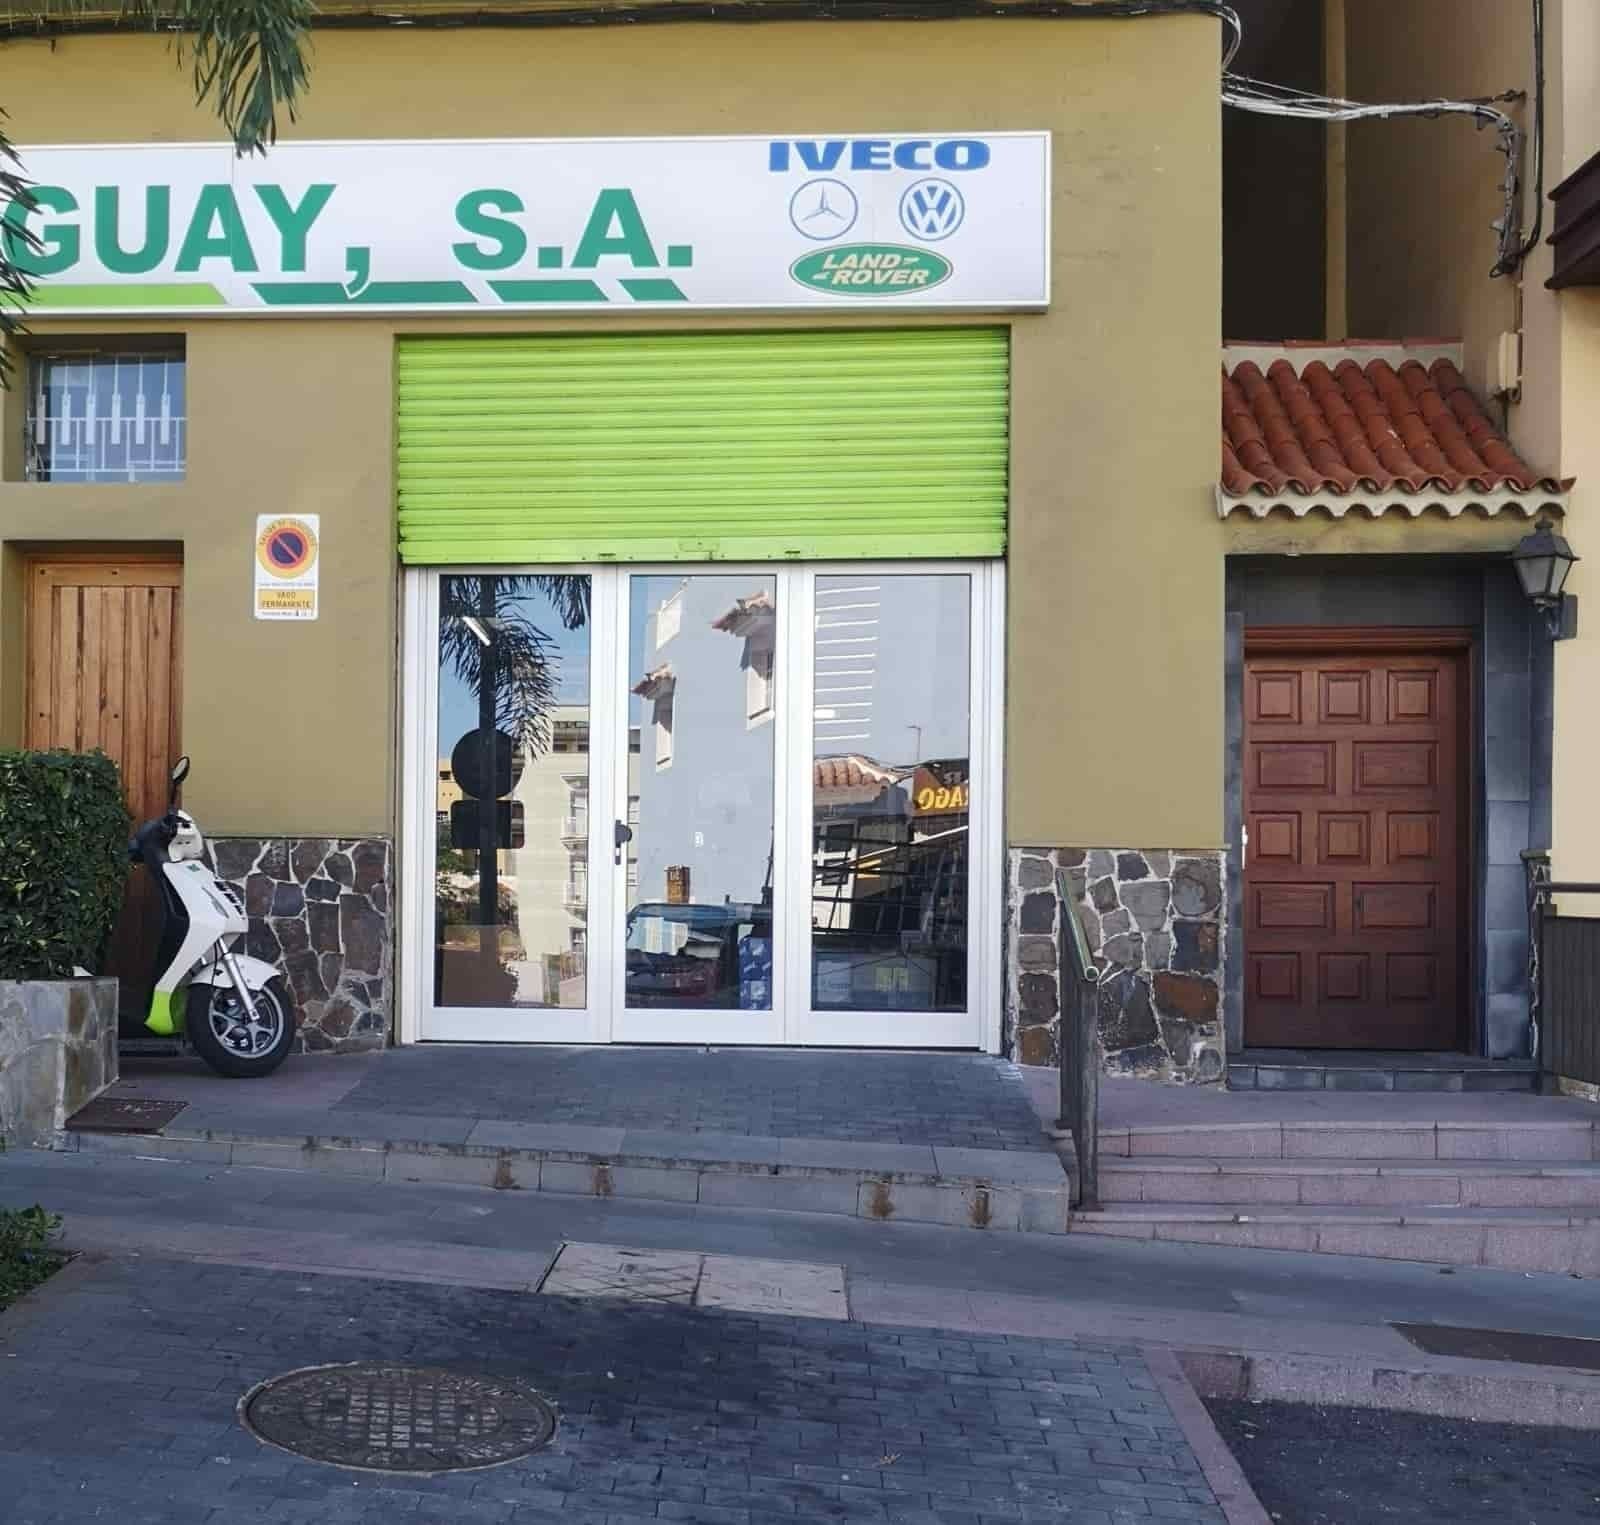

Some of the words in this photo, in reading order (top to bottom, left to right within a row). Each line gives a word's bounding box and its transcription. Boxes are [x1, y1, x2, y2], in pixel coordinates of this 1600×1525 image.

[768, 139, 991, 172] IVECO
[452, 187, 693, 271] S.A.
[822, 253, 901, 269] LAND
[831, 268, 930, 285] ROVER
